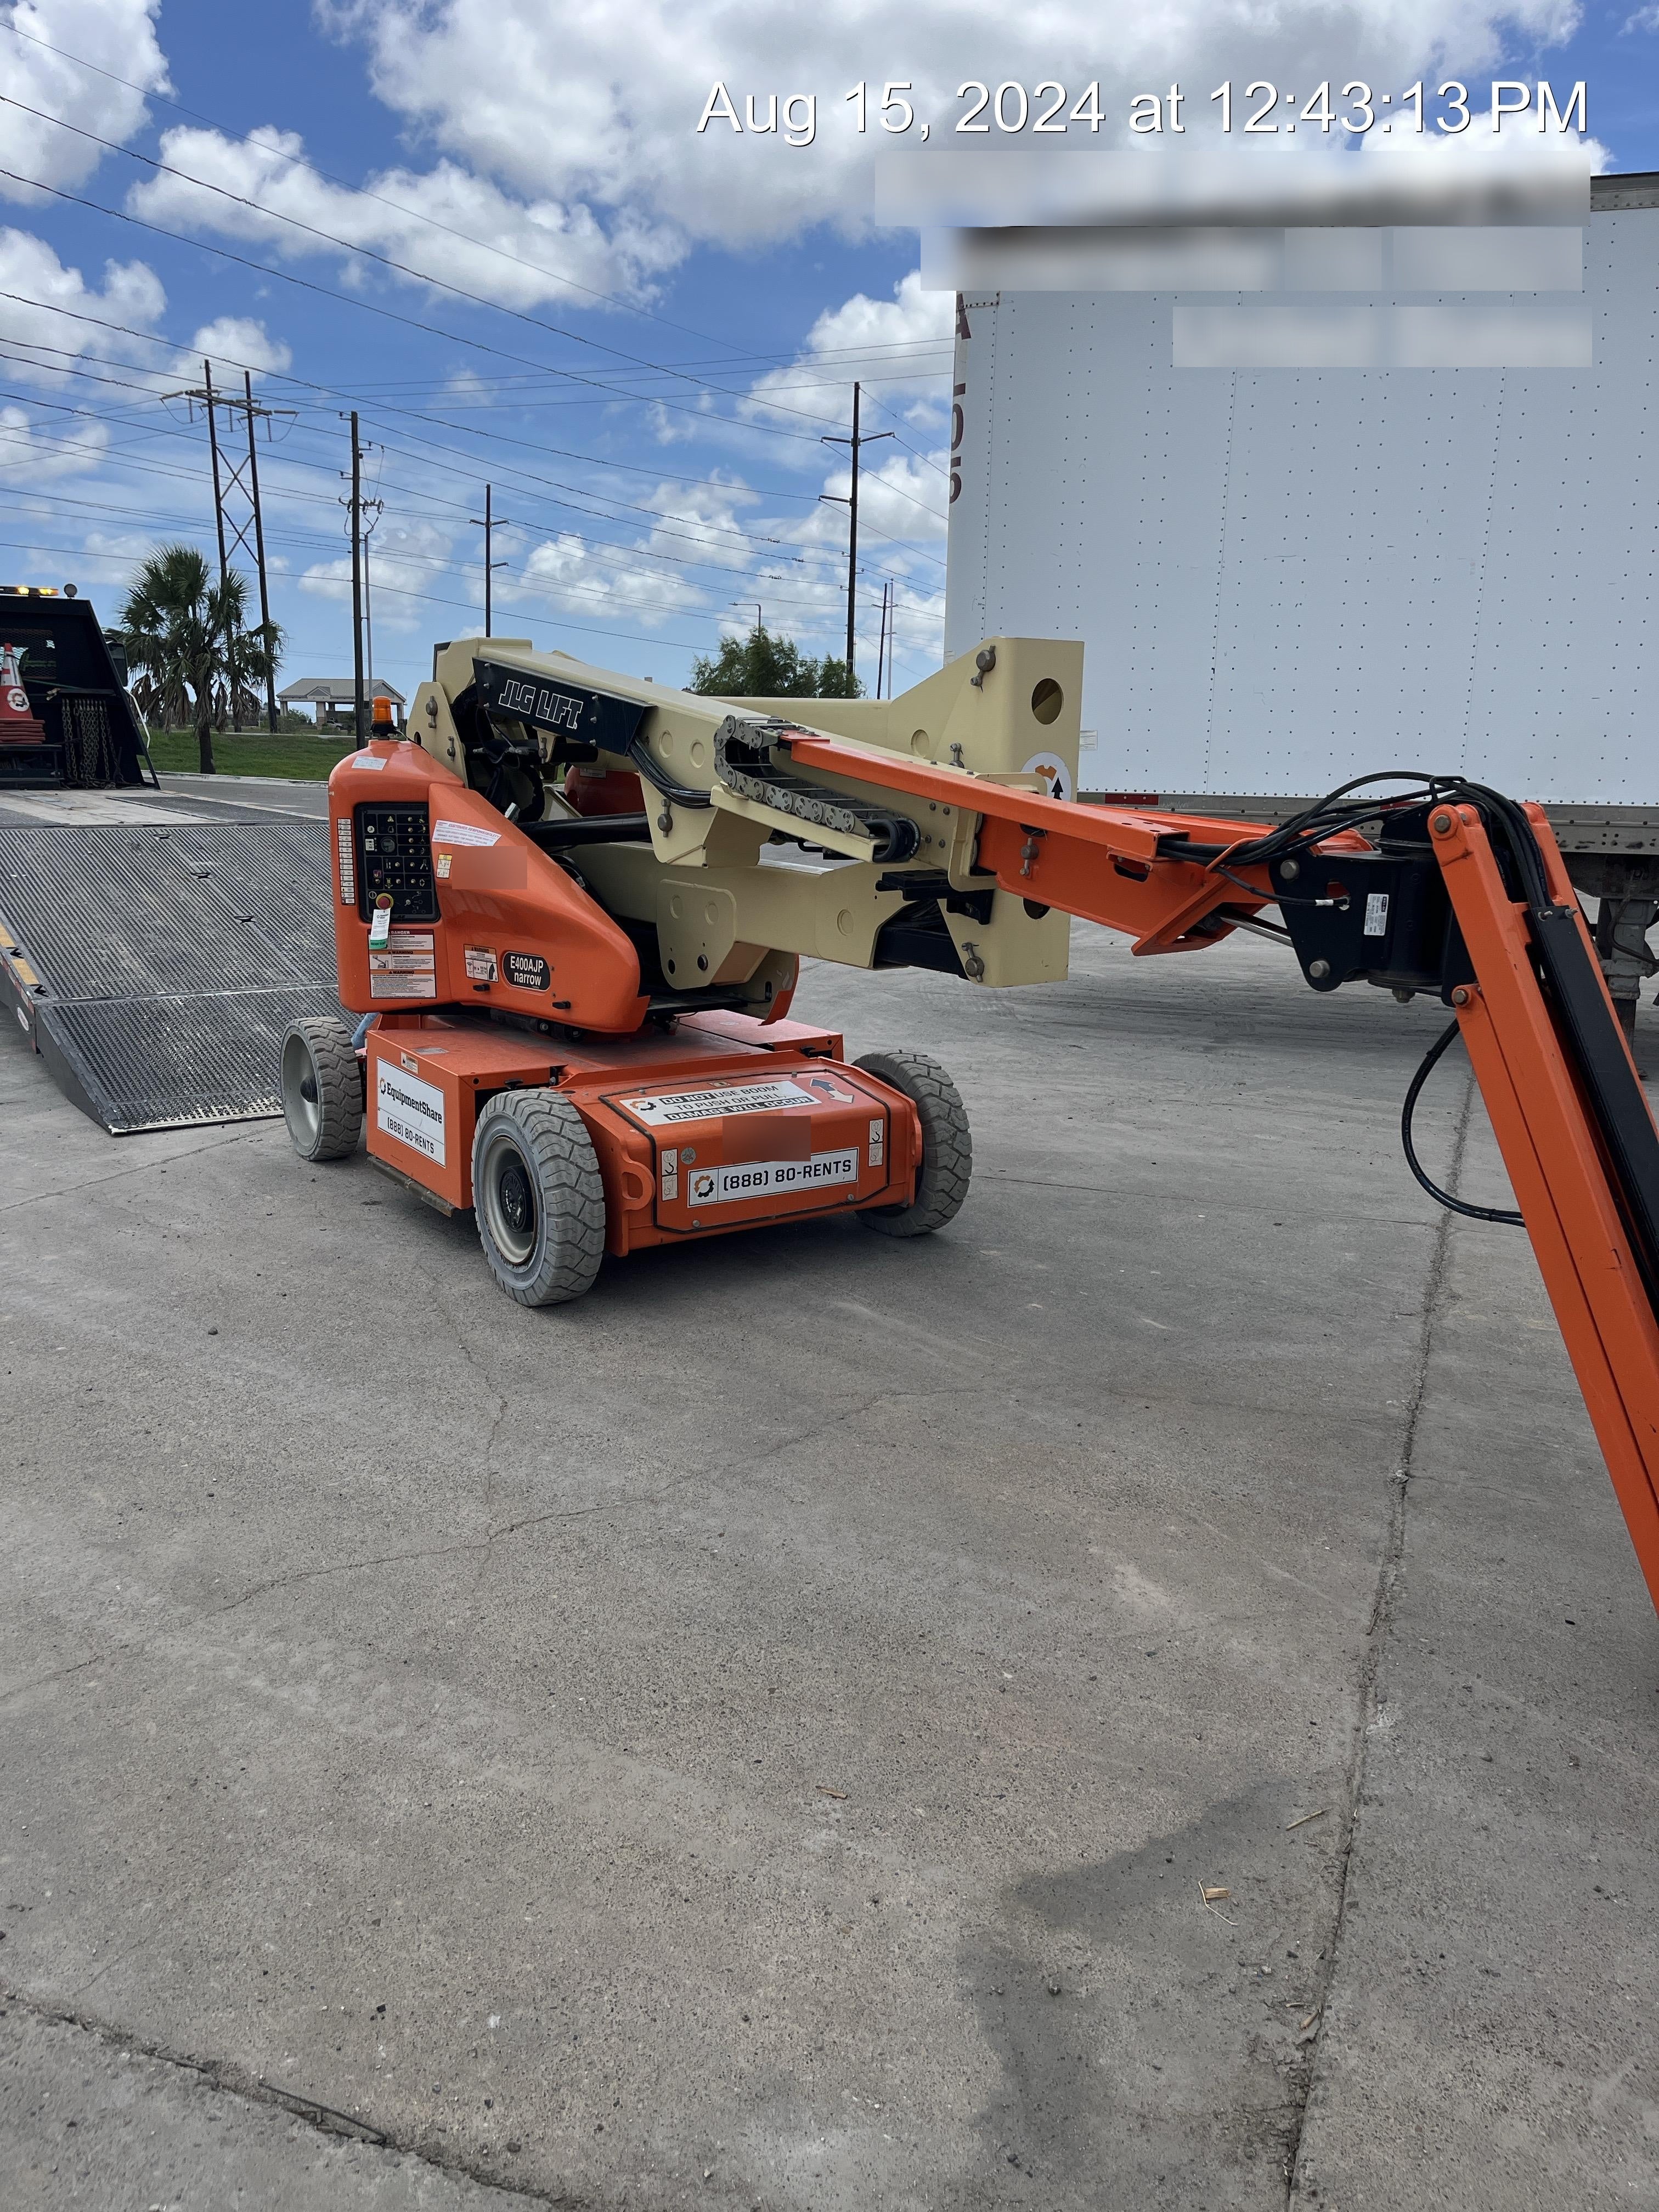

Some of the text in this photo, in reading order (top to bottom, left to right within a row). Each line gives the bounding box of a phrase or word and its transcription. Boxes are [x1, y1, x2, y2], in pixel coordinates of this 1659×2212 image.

[498, 679, 584, 729] JLG LIFT
[510, 955, 544, 973] E400AJP
[514, 972, 542, 986] narrow
[387, 1082, 442, 1124] EquipmentShare
[686, 1093, 713, 1103] NOT
[714, 1090, 738, 1098] USE
[740, 1085, 779, 1096] BOOM
[696, 1099, 728, 1109] PUSH
[752, 1092, 786, 1102] PULL,
[668, 1097, 811, 1121] DAMAGE WILL OCCUR
[387, 1116, 435, 1154] (888) 80-RENTS
[723, 1159, 851, 1191] (888) 80-RENTS
